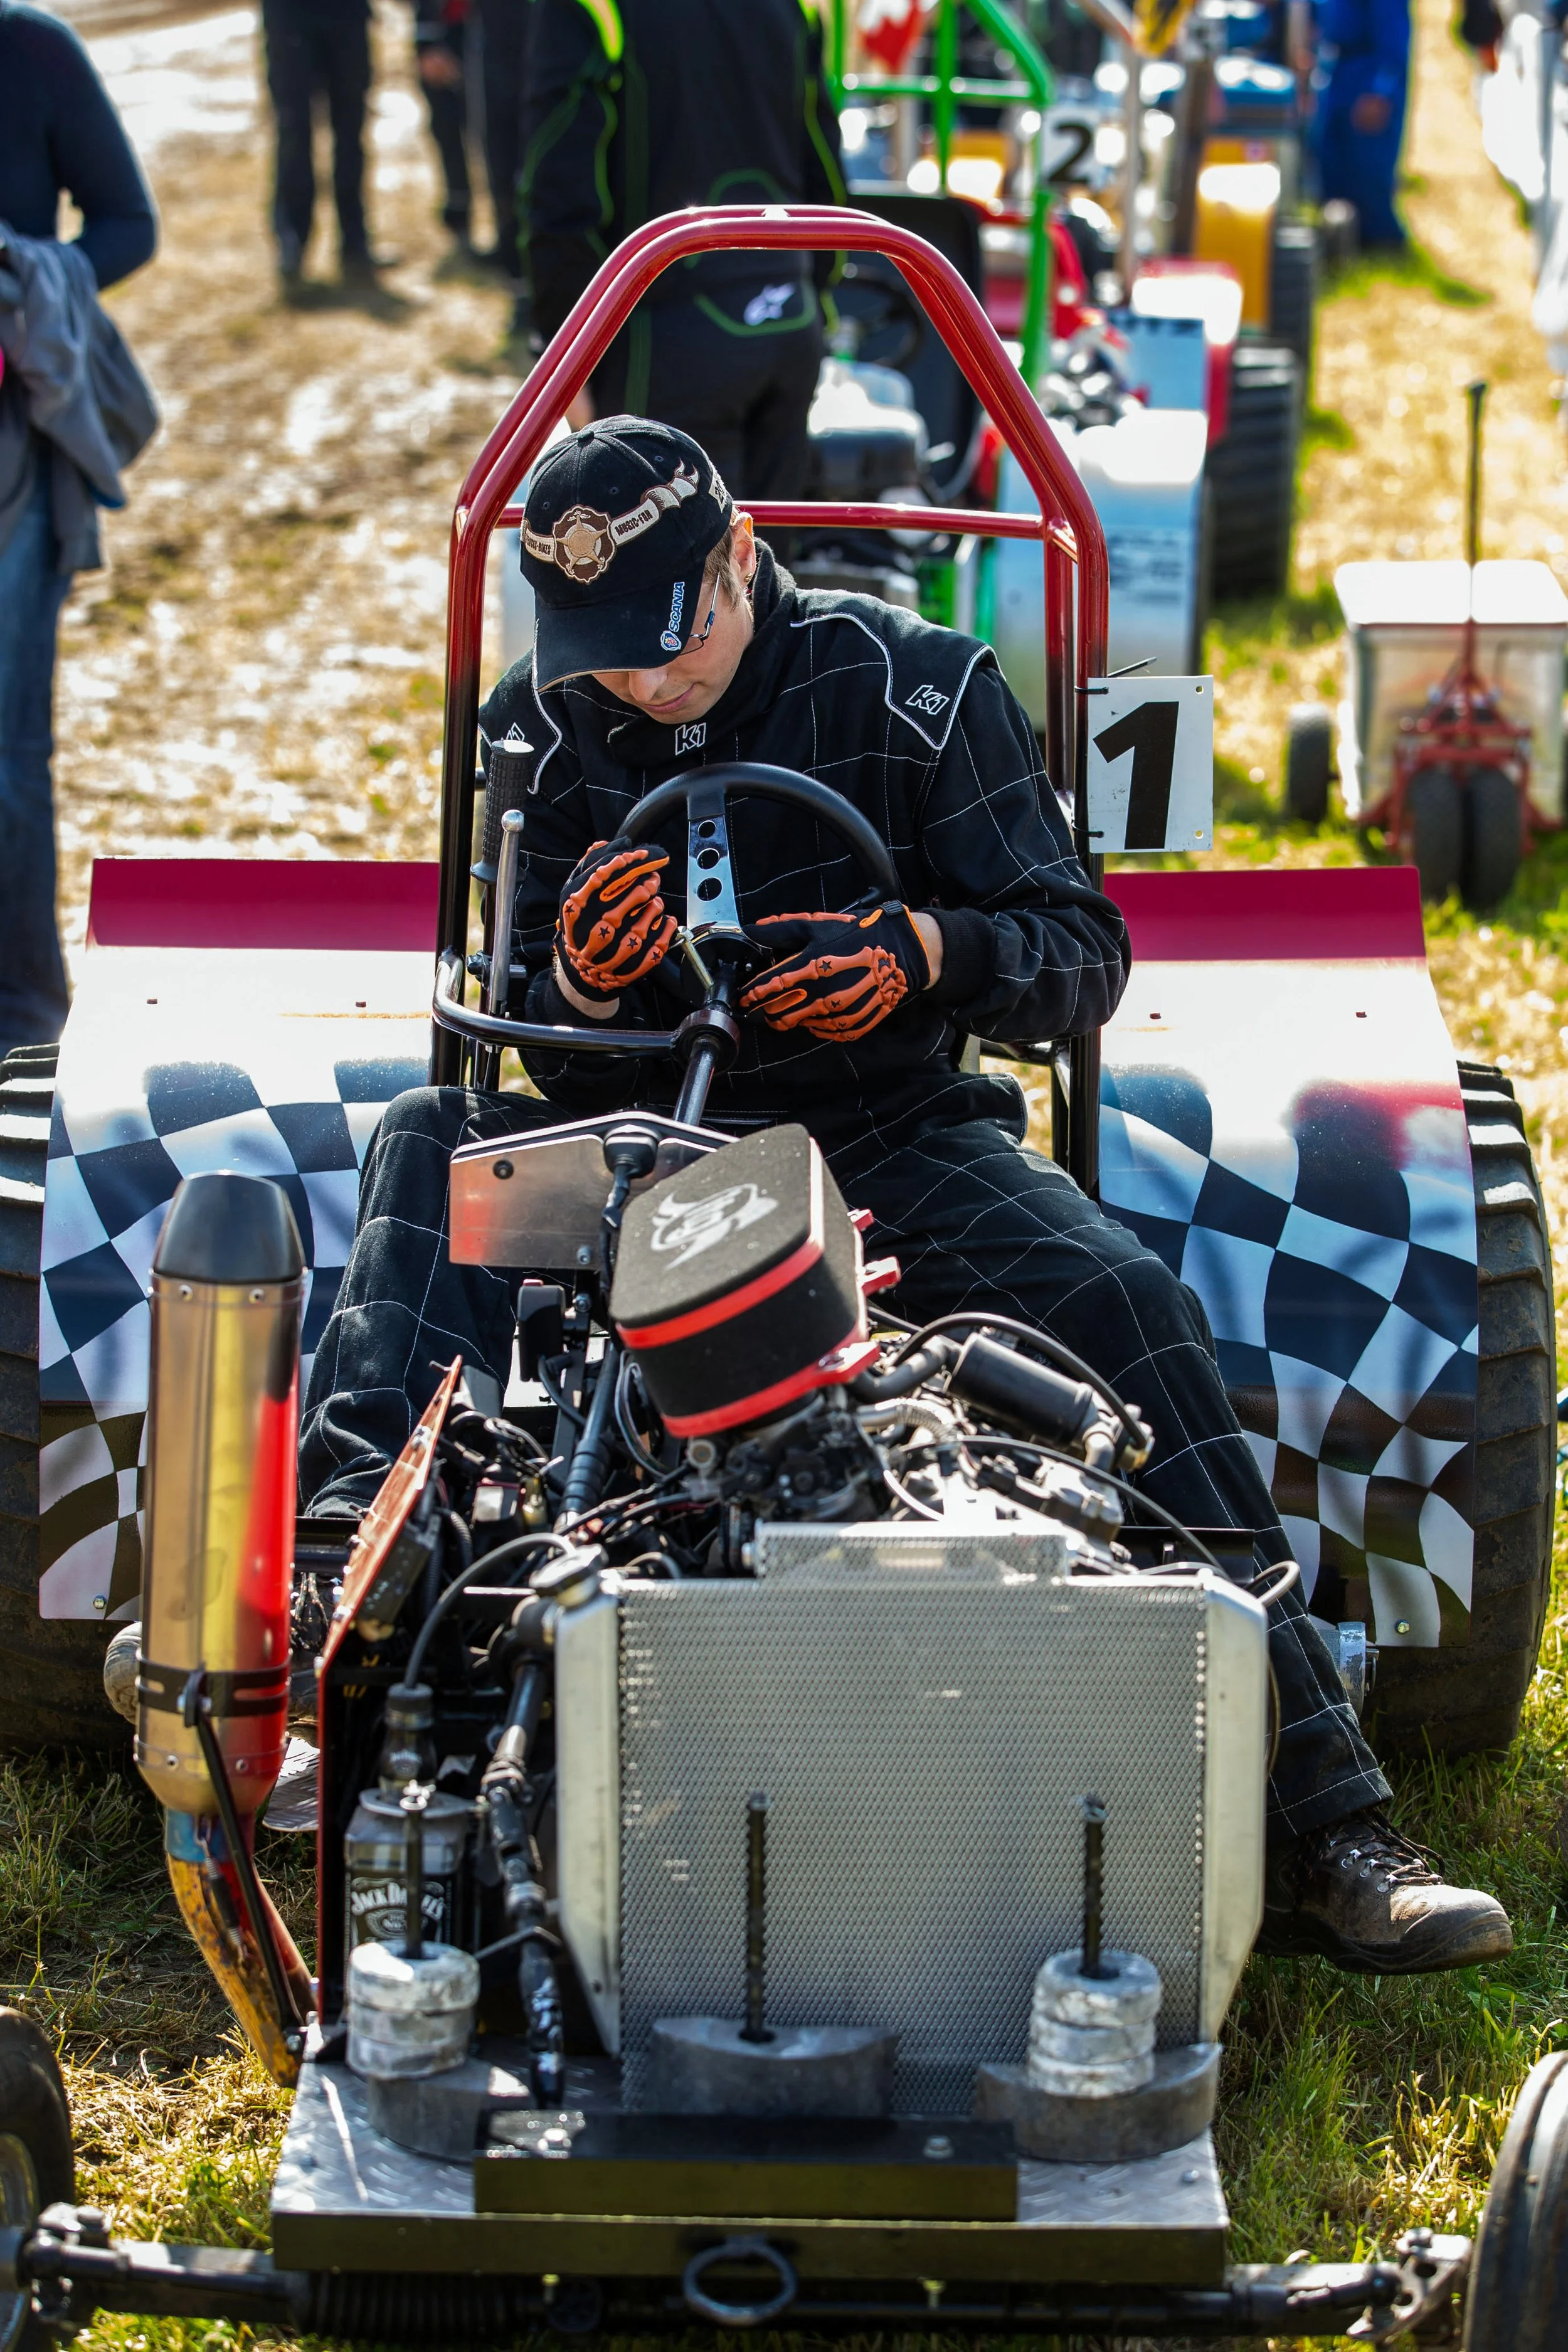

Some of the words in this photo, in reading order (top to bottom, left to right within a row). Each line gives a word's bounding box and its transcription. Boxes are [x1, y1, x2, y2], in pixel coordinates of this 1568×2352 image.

[1047, 120, 1094, 185] 2
[669, 582, 685, 632] SCANIA
[904, 684, 950, 715] K1
[675, 722, 706, 756] K1
[1093, 701, 1179, 850] 1
